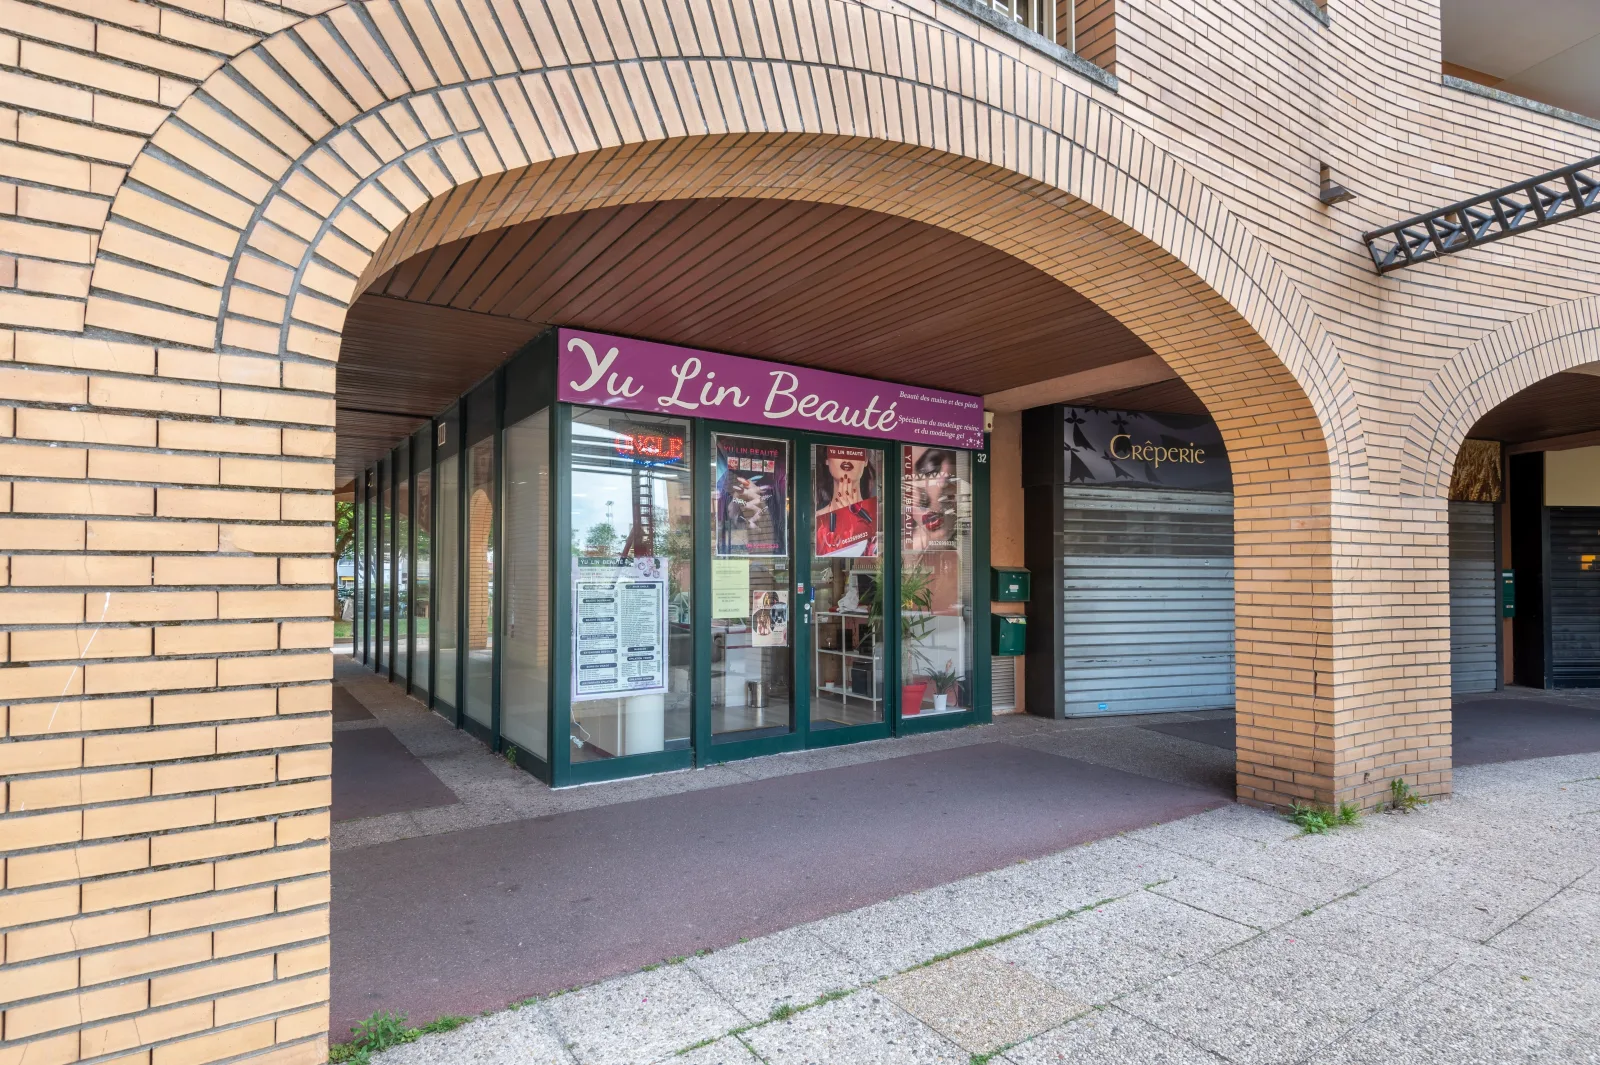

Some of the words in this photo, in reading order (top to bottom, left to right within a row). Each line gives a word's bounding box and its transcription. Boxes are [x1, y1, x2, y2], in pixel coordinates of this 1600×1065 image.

[567, 338, 644, 398] Yu
[657, 357, 750, 410] Lin
[763, 370, 898, 432] Beauté
[899, 390, 919, 400] Beauté
[920, 394, 930, 402] des
[930, 396, 948, 405] mains
[898, 414, 928, 425] Spécialiste
[937, 422, 963, 431] modelage
[920, 427, 929, 435] du
[929, 429, 956, 440] modelage
[956, 432, 965, 440] gel
[614, 434, 683, 458] ONGLE
[904, 454, 912, 469] YU
[977, 453, 987, 463] 32
